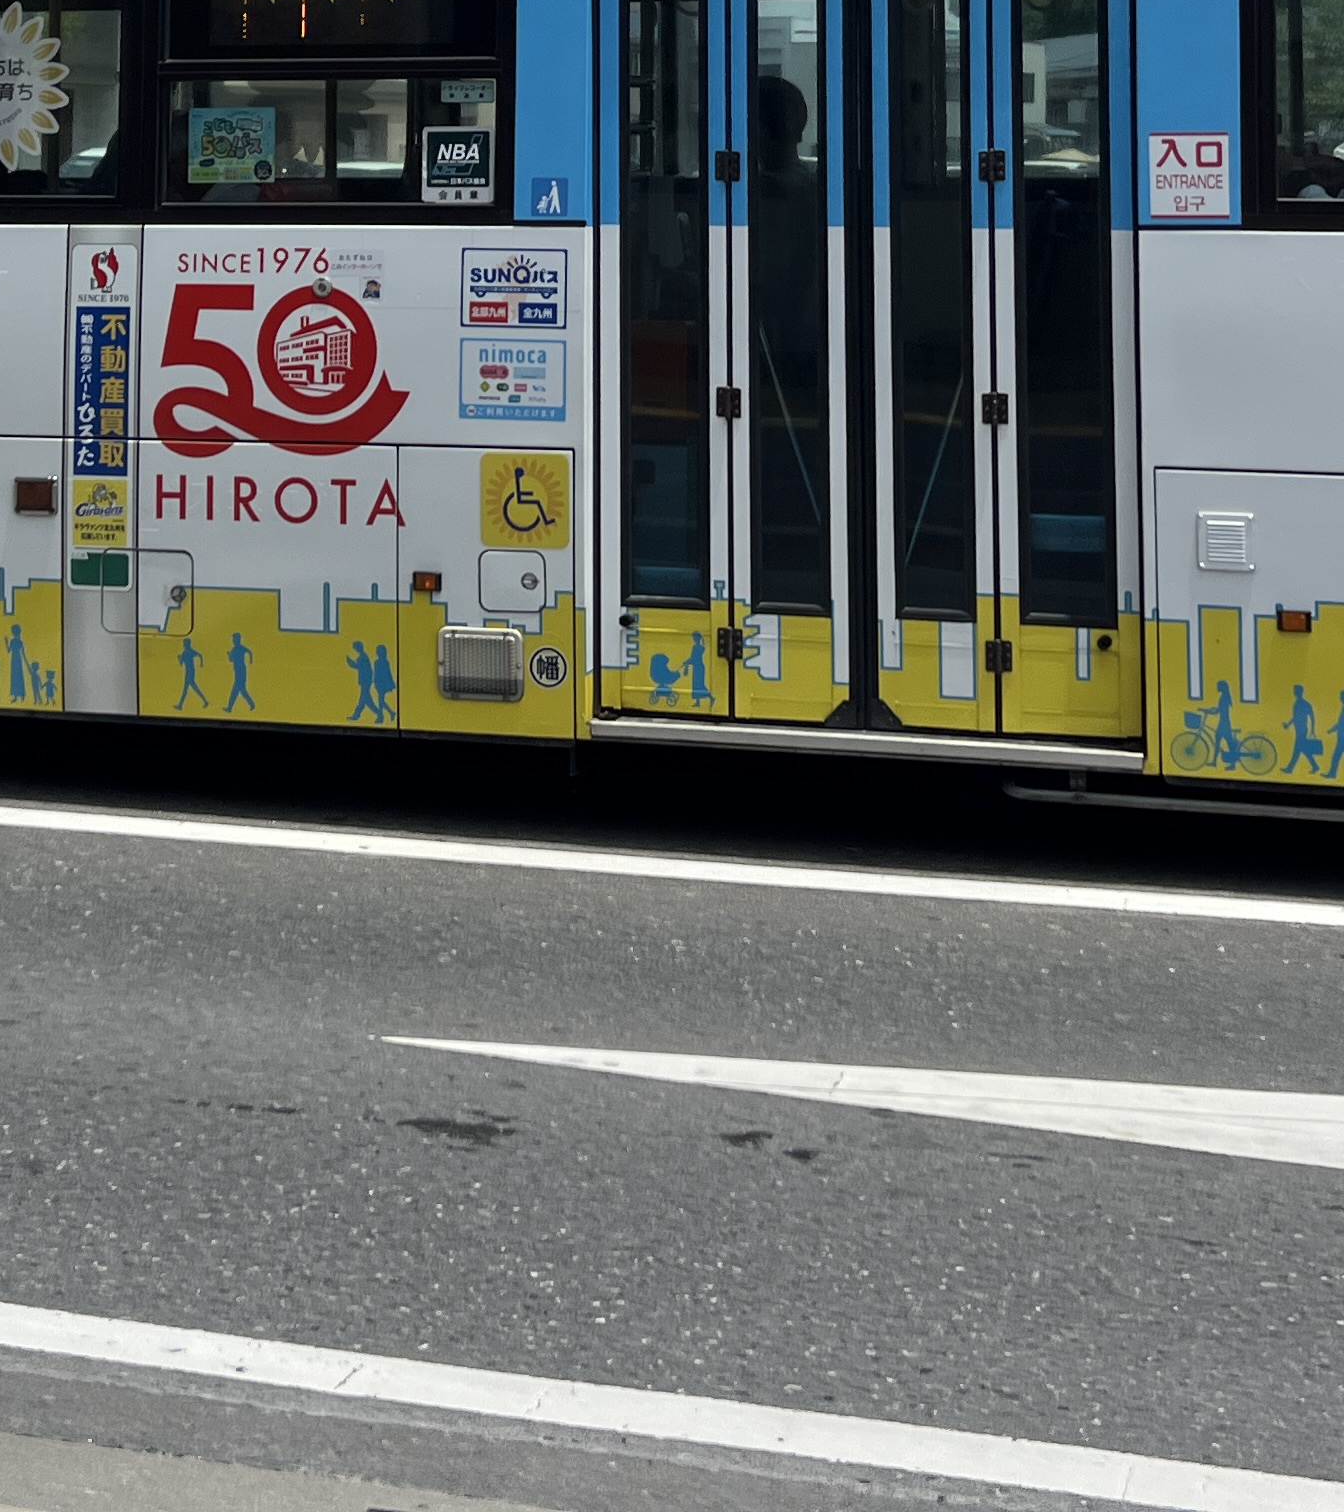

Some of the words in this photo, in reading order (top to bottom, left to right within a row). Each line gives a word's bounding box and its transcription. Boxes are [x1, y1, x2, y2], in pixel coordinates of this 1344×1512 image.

[437, 143, 480, 161] NBA
[1156, 138, 1223, 168] 入口
[1155, 173, 1224, 190] ENTRANCE
[1173, 195, 1206, 212] 입구
[77, 294, 108, 303] SINCE
[479, 343, 547, 364] nimoca
[99, 313, 128, 469] 不動産買取
[155, 473, 407, 528] HIROTA
